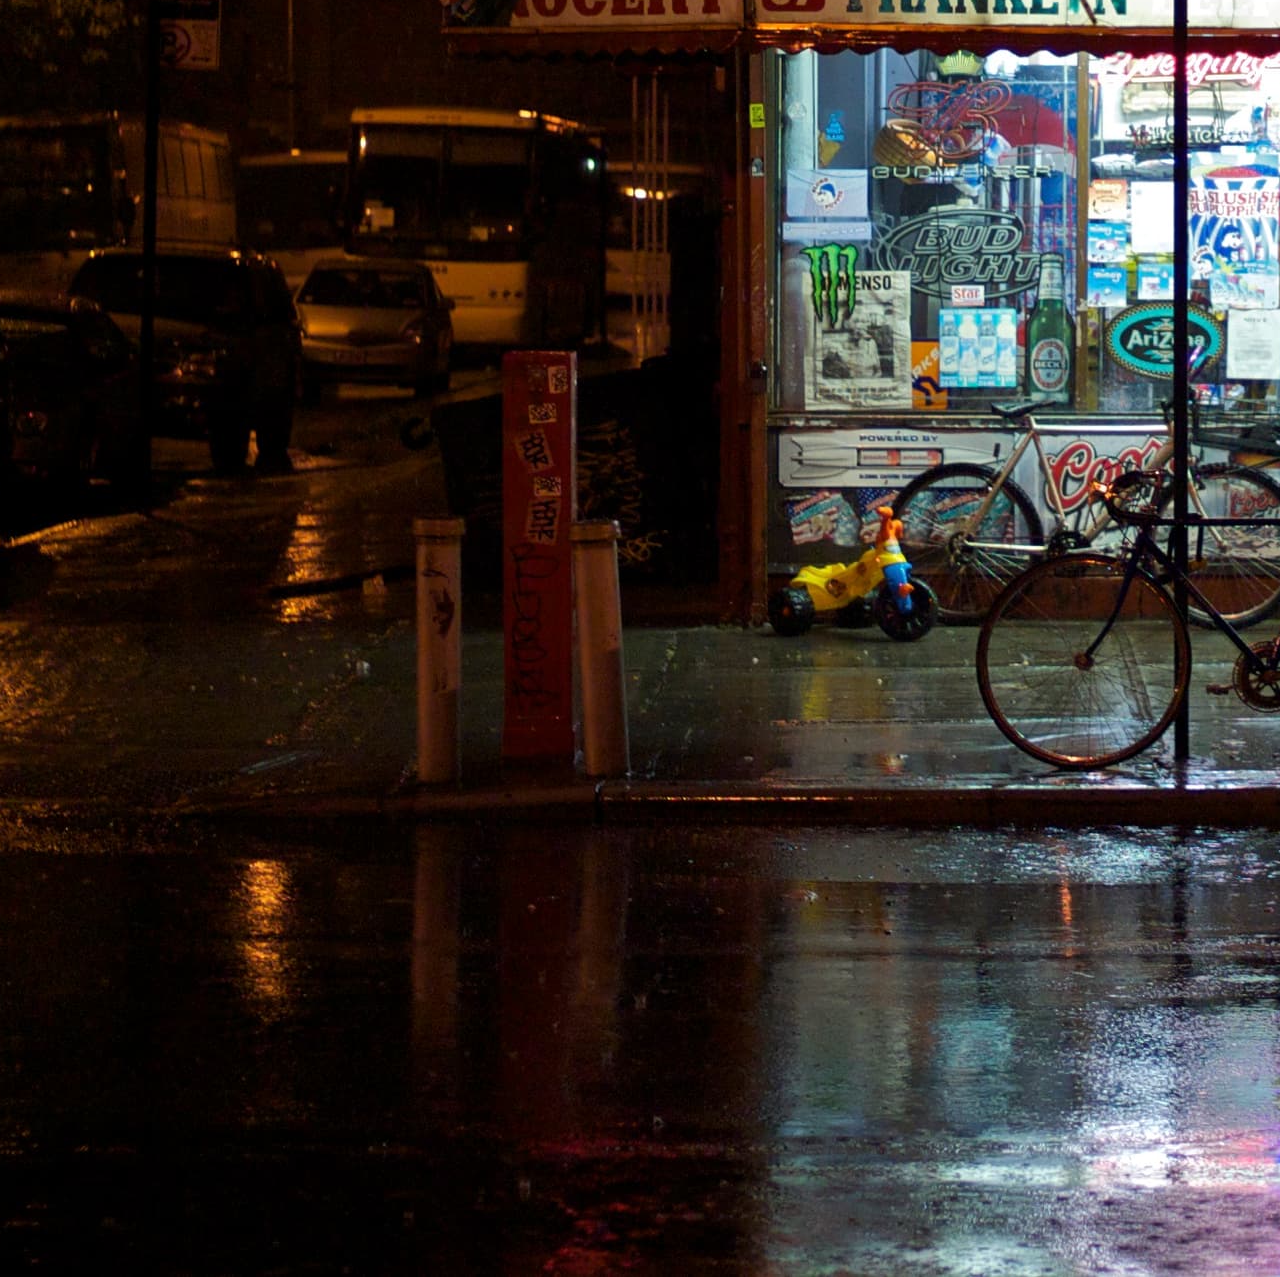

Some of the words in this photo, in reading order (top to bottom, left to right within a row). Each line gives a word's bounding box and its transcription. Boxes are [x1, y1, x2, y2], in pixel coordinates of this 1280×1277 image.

[872, 165, 1051, 180] BUDWEISER
[1207, 191, 1258, 205] SLUSH
[914, 224, 1023, 255] BUD
[898, 253, 1041, 283] LIGHT
[953, 288, 980, 300] Star
[1126, 329, 1206, 350] AriZna
[1044, 436, 1176, 513] Coor
